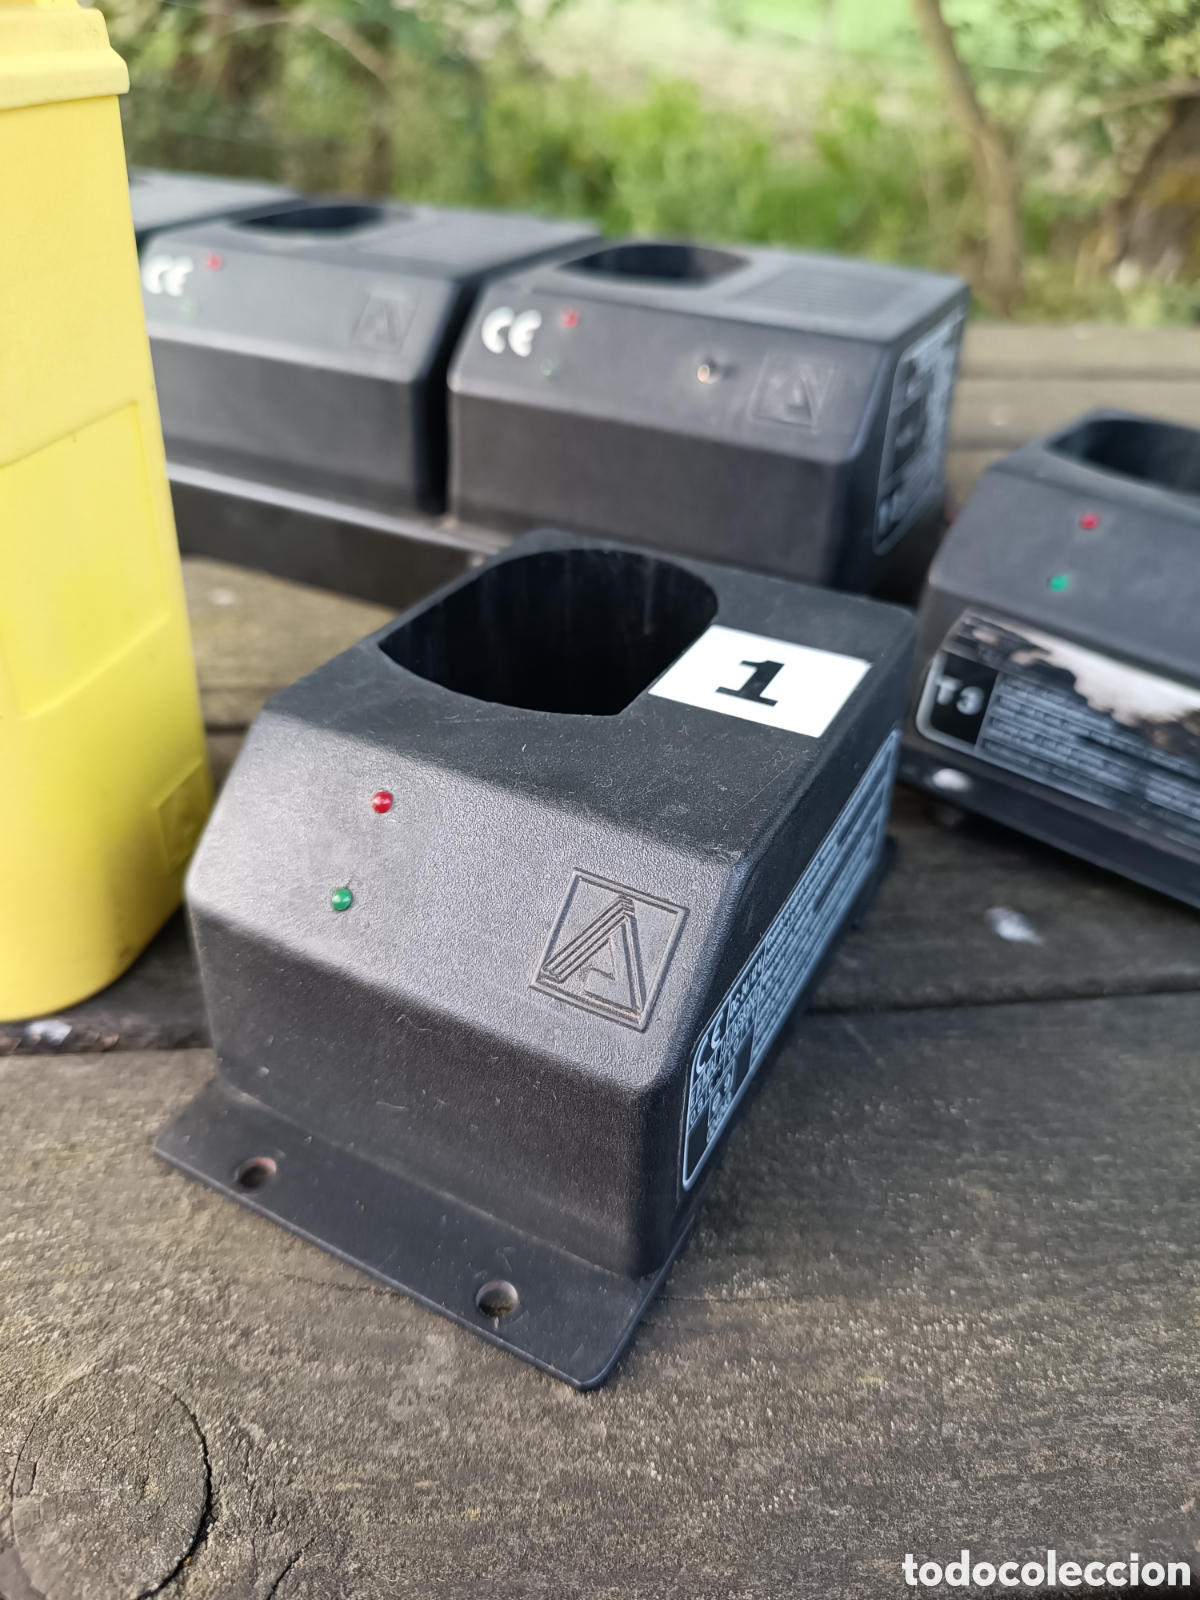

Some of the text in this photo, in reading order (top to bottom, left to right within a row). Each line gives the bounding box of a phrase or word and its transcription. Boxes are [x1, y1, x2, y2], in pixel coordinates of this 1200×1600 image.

[142, 255, 193, 296] CE
[481, 306, 542, 357] CE
[715, 660, 785, 707] 1
[696, 1012, 724, 1073] CE
